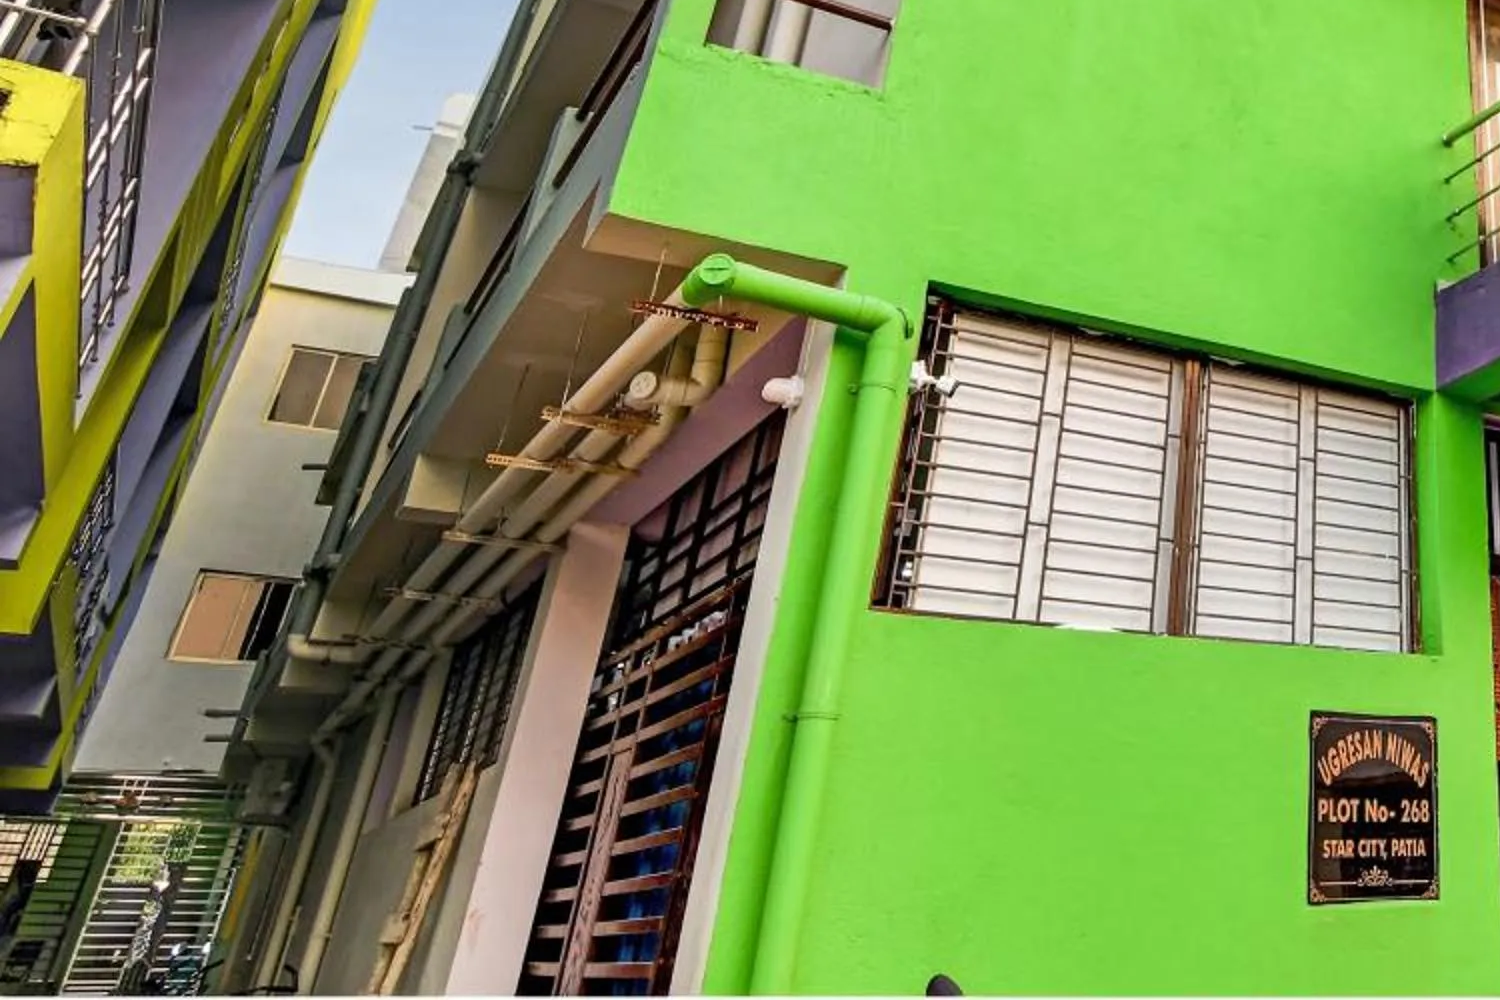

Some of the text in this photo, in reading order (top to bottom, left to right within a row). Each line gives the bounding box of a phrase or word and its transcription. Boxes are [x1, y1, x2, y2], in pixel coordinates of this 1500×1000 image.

[1317, 729, 1430, 788] UGRESAN NIWAS
[1317, 798, 1360, 823] PLOT
[1401, 799, 1430, 823] 268
[1323, 839, 1427, 860] STAR CITY, PATIA
